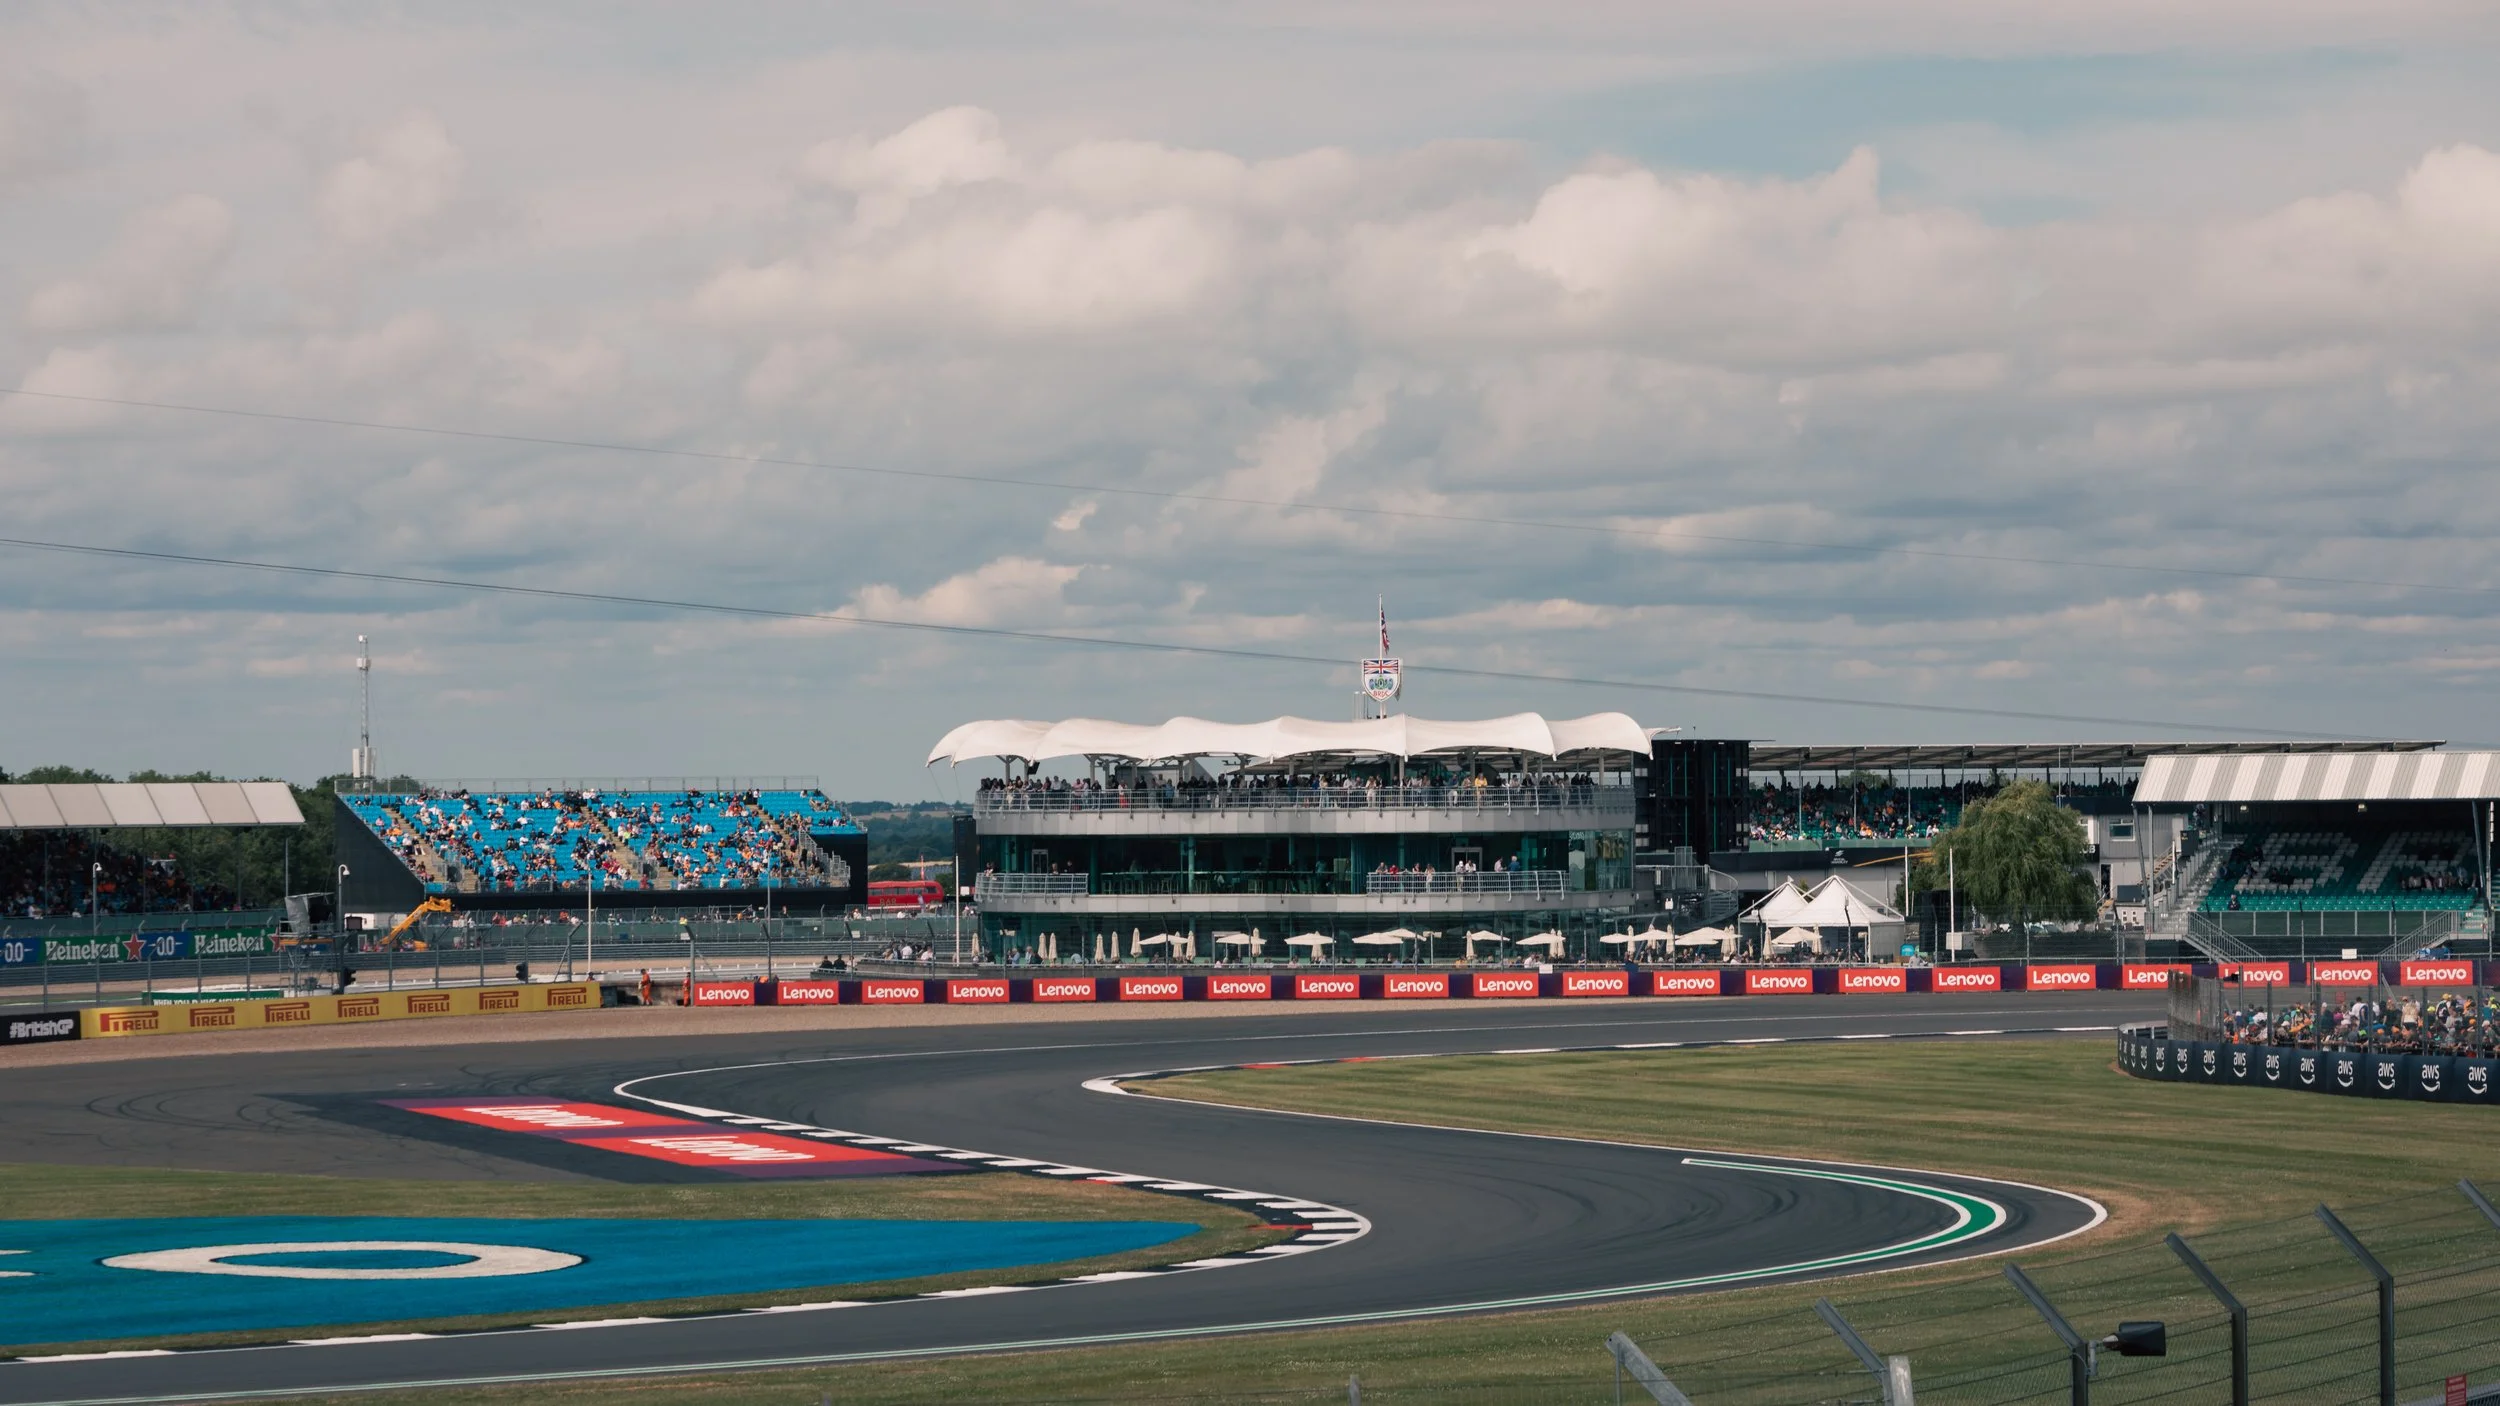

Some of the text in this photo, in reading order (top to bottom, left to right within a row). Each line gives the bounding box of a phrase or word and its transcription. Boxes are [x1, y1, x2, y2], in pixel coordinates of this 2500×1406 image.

[45, 940, 120, 961] Heineken
[194, 932, 265, 954] Heineken
[1845, 974, 1901, 988] Lenovo
[1938, 973, 1995, 986] Lenovo
[2033, 971, 2090, 985] Lenovo
[2313, 967, 2373, 981] Lenovo
[2406, 966, 2467, 981] Lenovo
[1125, 982, 1178, 996] Lenovo
[1213, 980, 1266, 995] Lenovo
[1301, 980, 1355, 993] Lenovo
[1389, 978, 1444, 993] Lenovo
[1479, 978, 1534, 992] Lenovo
[1568, 977, 1624, 991] Lenovo
[1659, 976, 1716, 990] Lenovo
[1751, 975, 1808, 989] Lenovo
[547, 987, 587, 1006] PIRELLI
[699, 987, 750, 1000] Lenovo
[783, 986, 834, 1000] Lenovo
[867, 985, 919, 999] Lenovo
[952, 985, 1005, 998] Lenovo
[1038, 984, 1091, 997] Lenovo
[337, 997, 380, 1018] PIRELLI
[407, 993, 450, 1014] PIRELLI
[479, 990, 519, 1010] PIRELLI
[190, 1006, 235, 1028] PIRELLI
[264, 1002, 311, 1023] PIRELLI
[10, 1019, 74, 1039] #BritishGP
[100, 1010, 160, 1033] PIRELLI
[2177, 1048, 2187, 1062] aws
[2203, 1050, 2216, 1064] aws
[2233, 1051, 2247, 1066] aws
[2266, 1054, 2280, 1069] aws
[2300, 1057, 2315, 1072] aws
[2338, 1060, 2353, 1075] aws
[2378, 1062, 2395, 1078] aws
[2422, 1064, 2440, 1080] aws
[2468, 1066, 2487, 1082] aws
